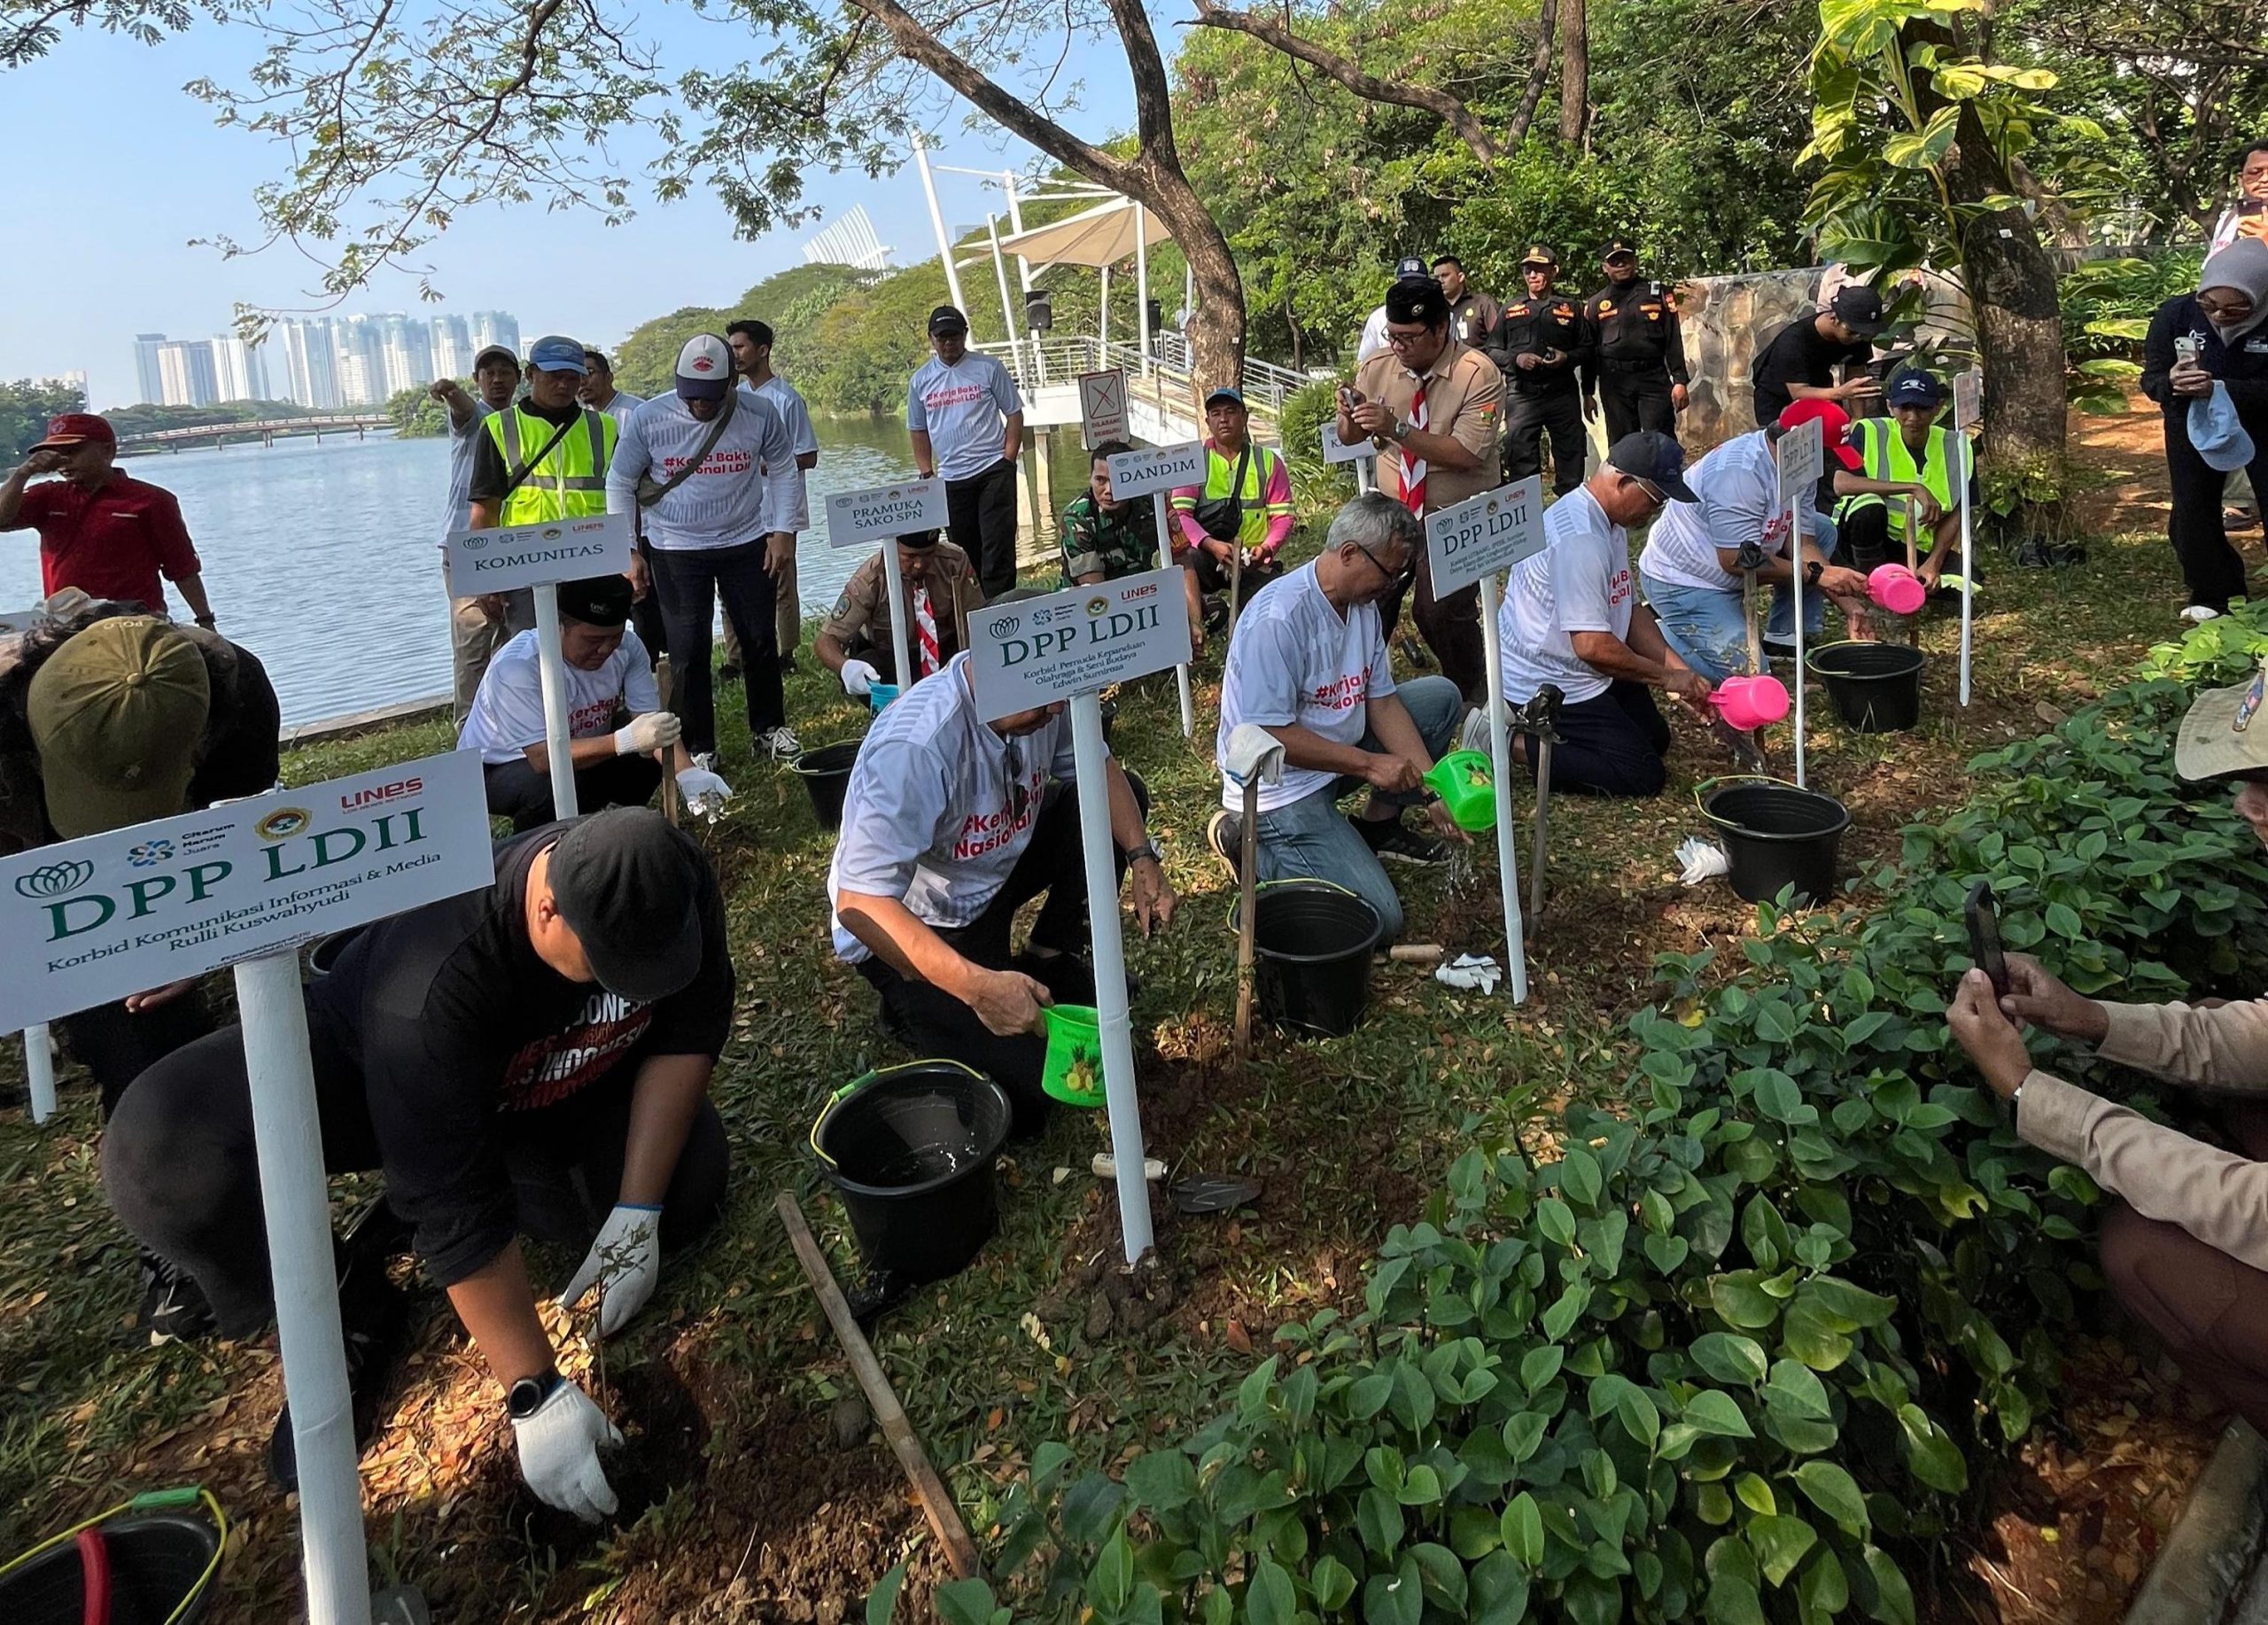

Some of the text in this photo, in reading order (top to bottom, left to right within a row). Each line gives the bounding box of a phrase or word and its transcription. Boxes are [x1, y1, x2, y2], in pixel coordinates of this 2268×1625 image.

[958, 384, 981, 393] Bakti
[965, 392, 982, 401] LDII
[716, 450, 751, 463] Bakti
[665, 462, 750, 477] Nonal LDII
[1119, 459, 1195, 484] DANDIM
[852, 500, 923, 518] PRAMUKA
[855, 509, 922, 529] SAKO SPN
[1442, 524, 1482, 556] DPP
[1488, 504, 1526, 536] LDII
[474, 543, 604, 571] KOMUNITAS
[999, 603, 1160, 668] DPP LDII
[1023, 641, 1146, 680] Korbid Pemuda Kepanduan
[1035, 668, 1076, 685] Olahraga
[1085, 659, 1104, 671] Seni
[1107, 651, 1137, 665] Budaya
[1052, 675, 1082, 689] Edwin
[1083, 664, 1123, 679] Sumiroza
[183, 834, 226, 848] Harum
[953, 808, 1031, 859] Nasional
[183, 844, 220, 856] Juara
[41, 806, 427, 943] DPP LDII
[48, 853, 441, 973] Korbid Komunikasi Informasi & Media
[169, 928, 217, 952] Rulli
[224, 890, 350, 936] Kuswahyudi
